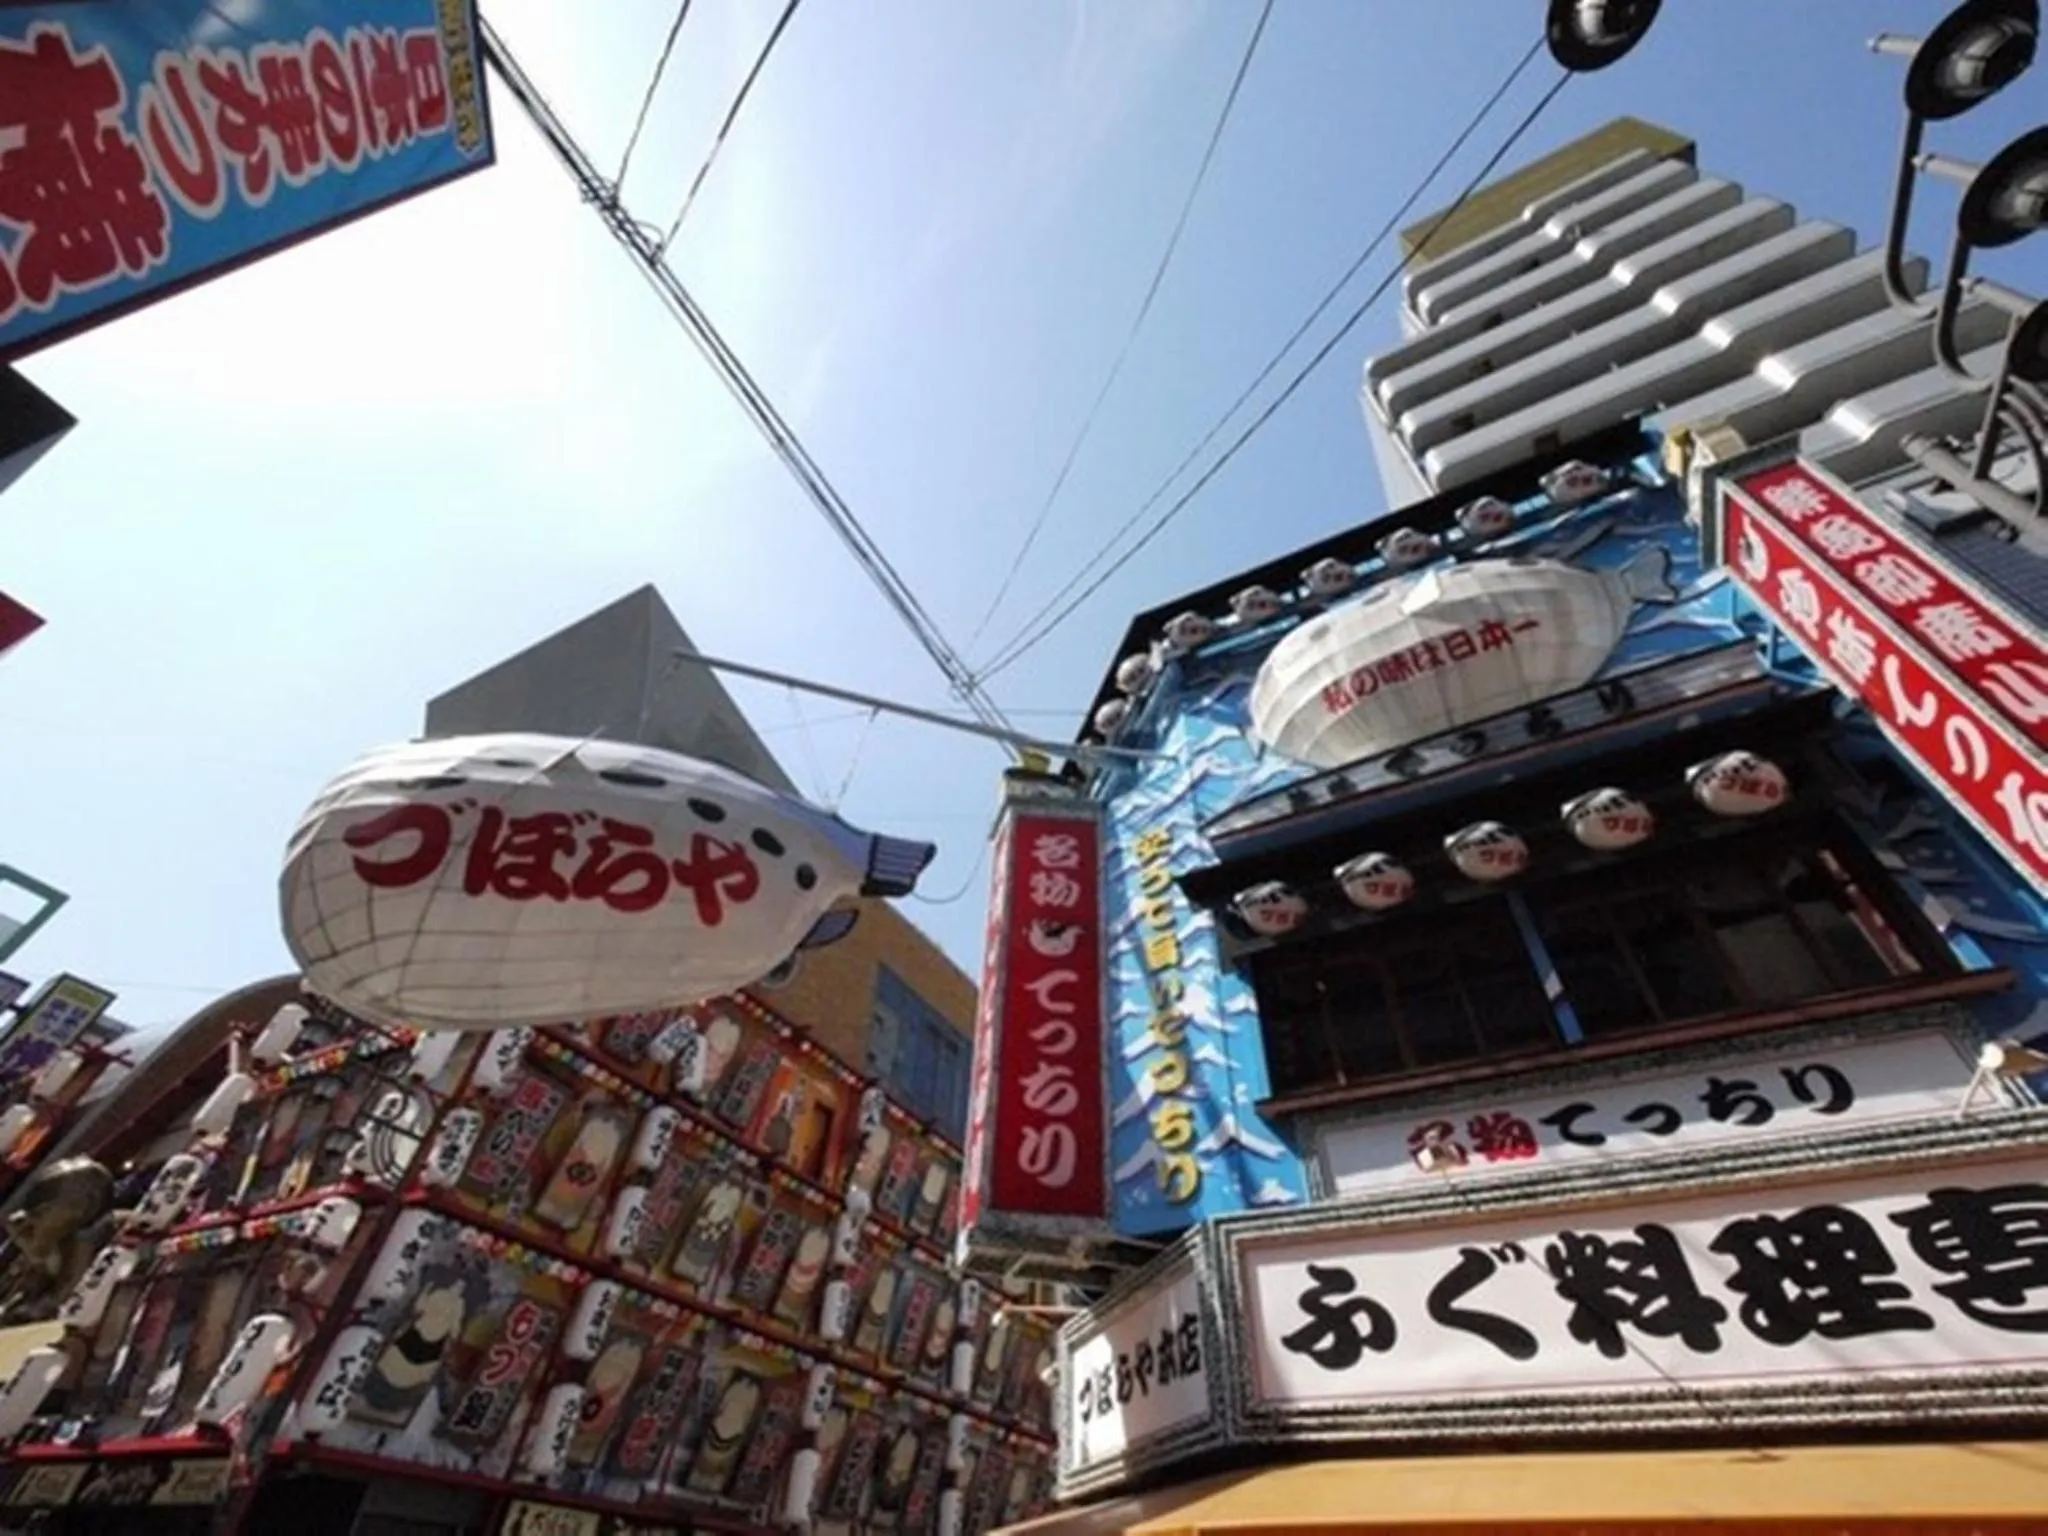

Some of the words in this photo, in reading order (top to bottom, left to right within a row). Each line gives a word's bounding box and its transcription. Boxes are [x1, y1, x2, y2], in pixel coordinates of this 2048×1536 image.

[0, 30, 168, 312] 横
[144, 29, 448, 208] 日本一の串かつ
[343, 797, 761, 927] づぼらや
